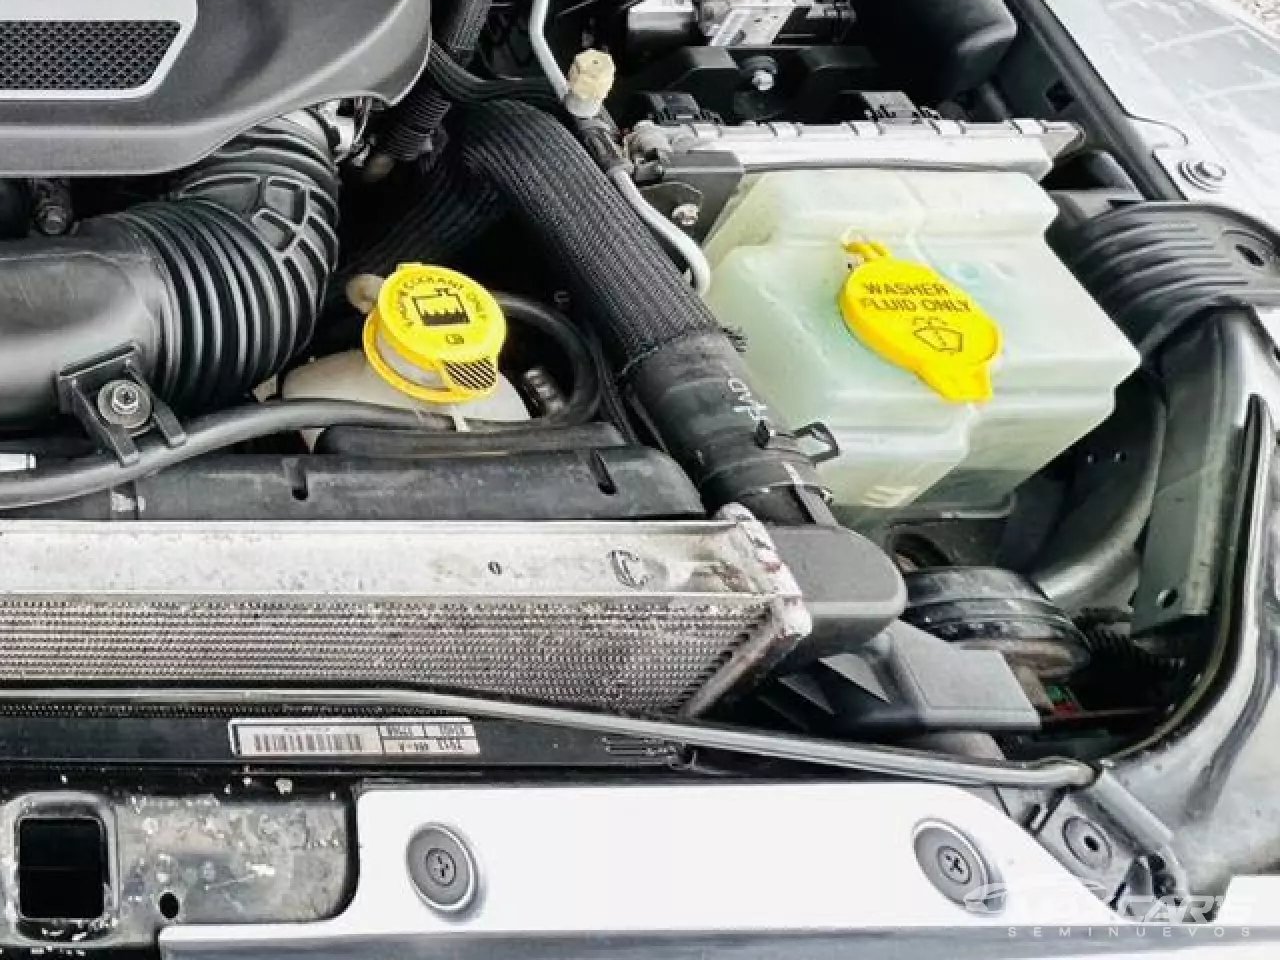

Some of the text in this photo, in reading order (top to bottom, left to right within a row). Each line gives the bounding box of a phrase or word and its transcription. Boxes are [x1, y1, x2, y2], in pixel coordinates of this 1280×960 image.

[864, 282, 949, 295] WASHER
[861, 297, 971, 312] FLUID ONLY
